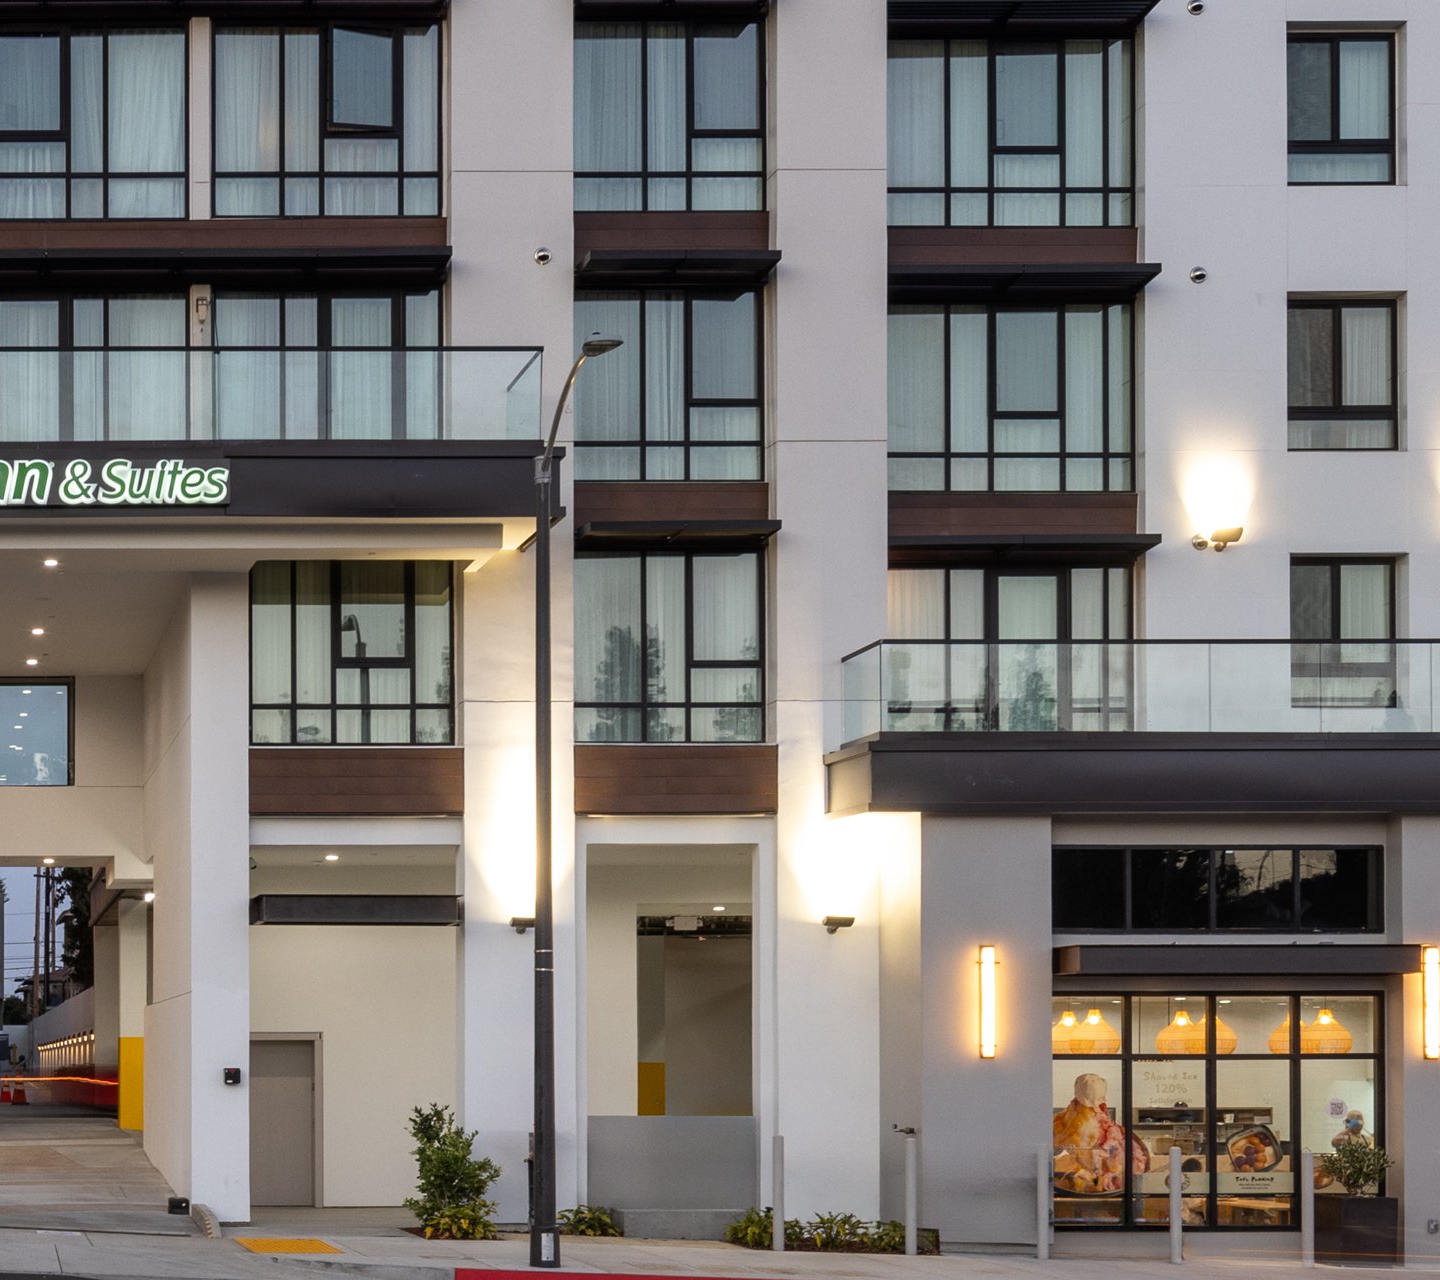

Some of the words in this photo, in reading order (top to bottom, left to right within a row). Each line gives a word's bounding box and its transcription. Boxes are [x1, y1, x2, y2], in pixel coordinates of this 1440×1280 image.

[59, 459, 97, 505] &
[98, 458, 229, 504] Suites
[1155, 1083, 1188, 1093] 120%
